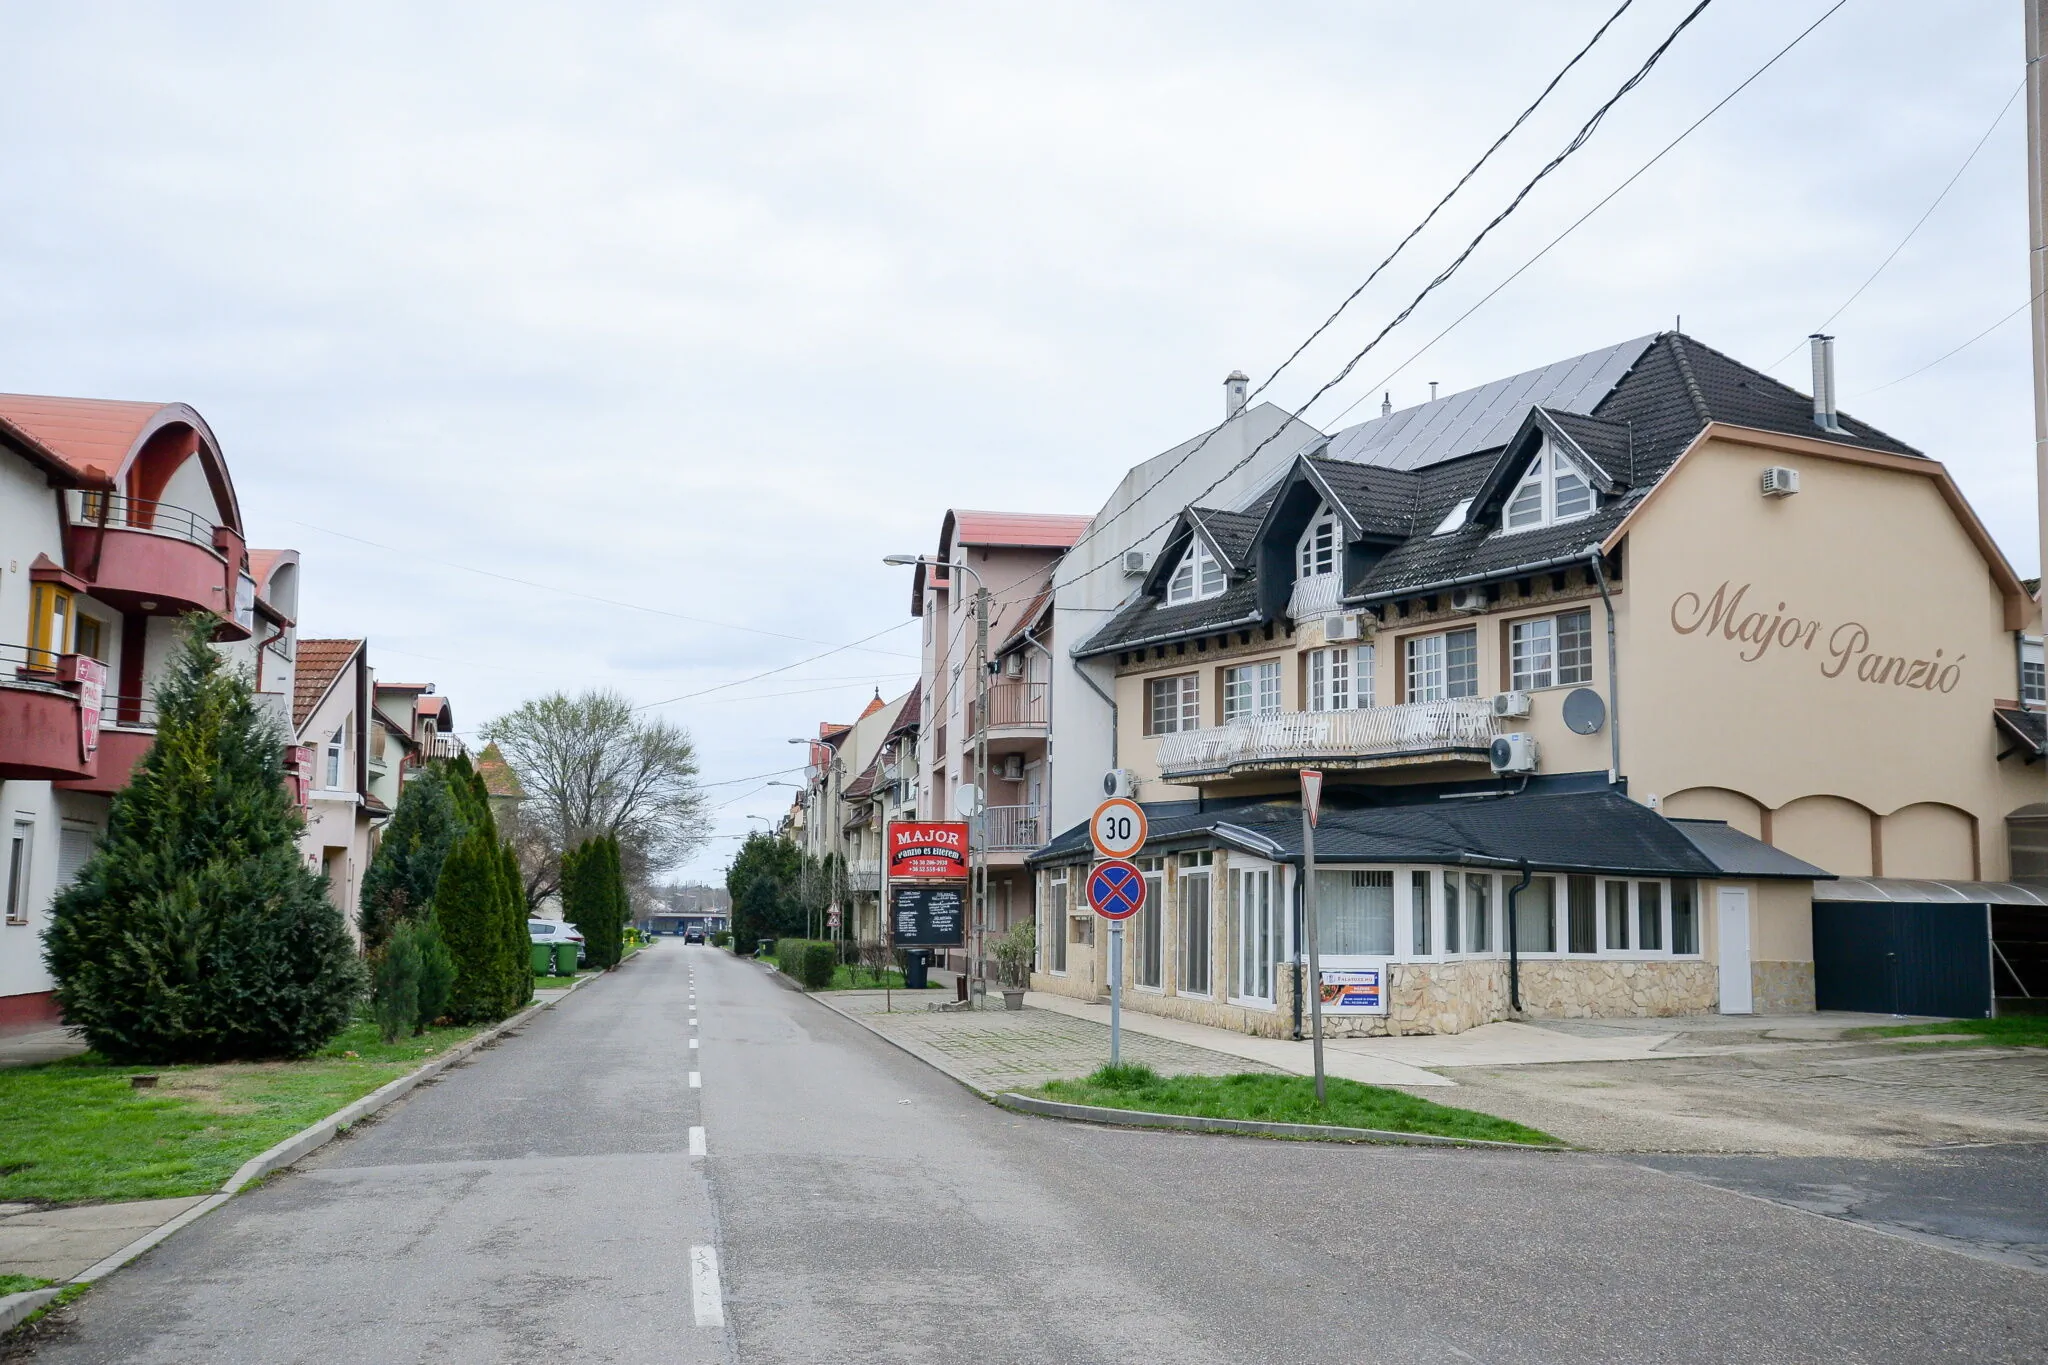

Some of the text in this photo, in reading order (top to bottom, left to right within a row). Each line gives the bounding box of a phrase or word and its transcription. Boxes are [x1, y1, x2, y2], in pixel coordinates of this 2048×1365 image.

[1671, 580, 1966, 693] Major Panzió
[896, 829, 959, 846] MAJOR
[1106, 817, 1131, 840] 30
